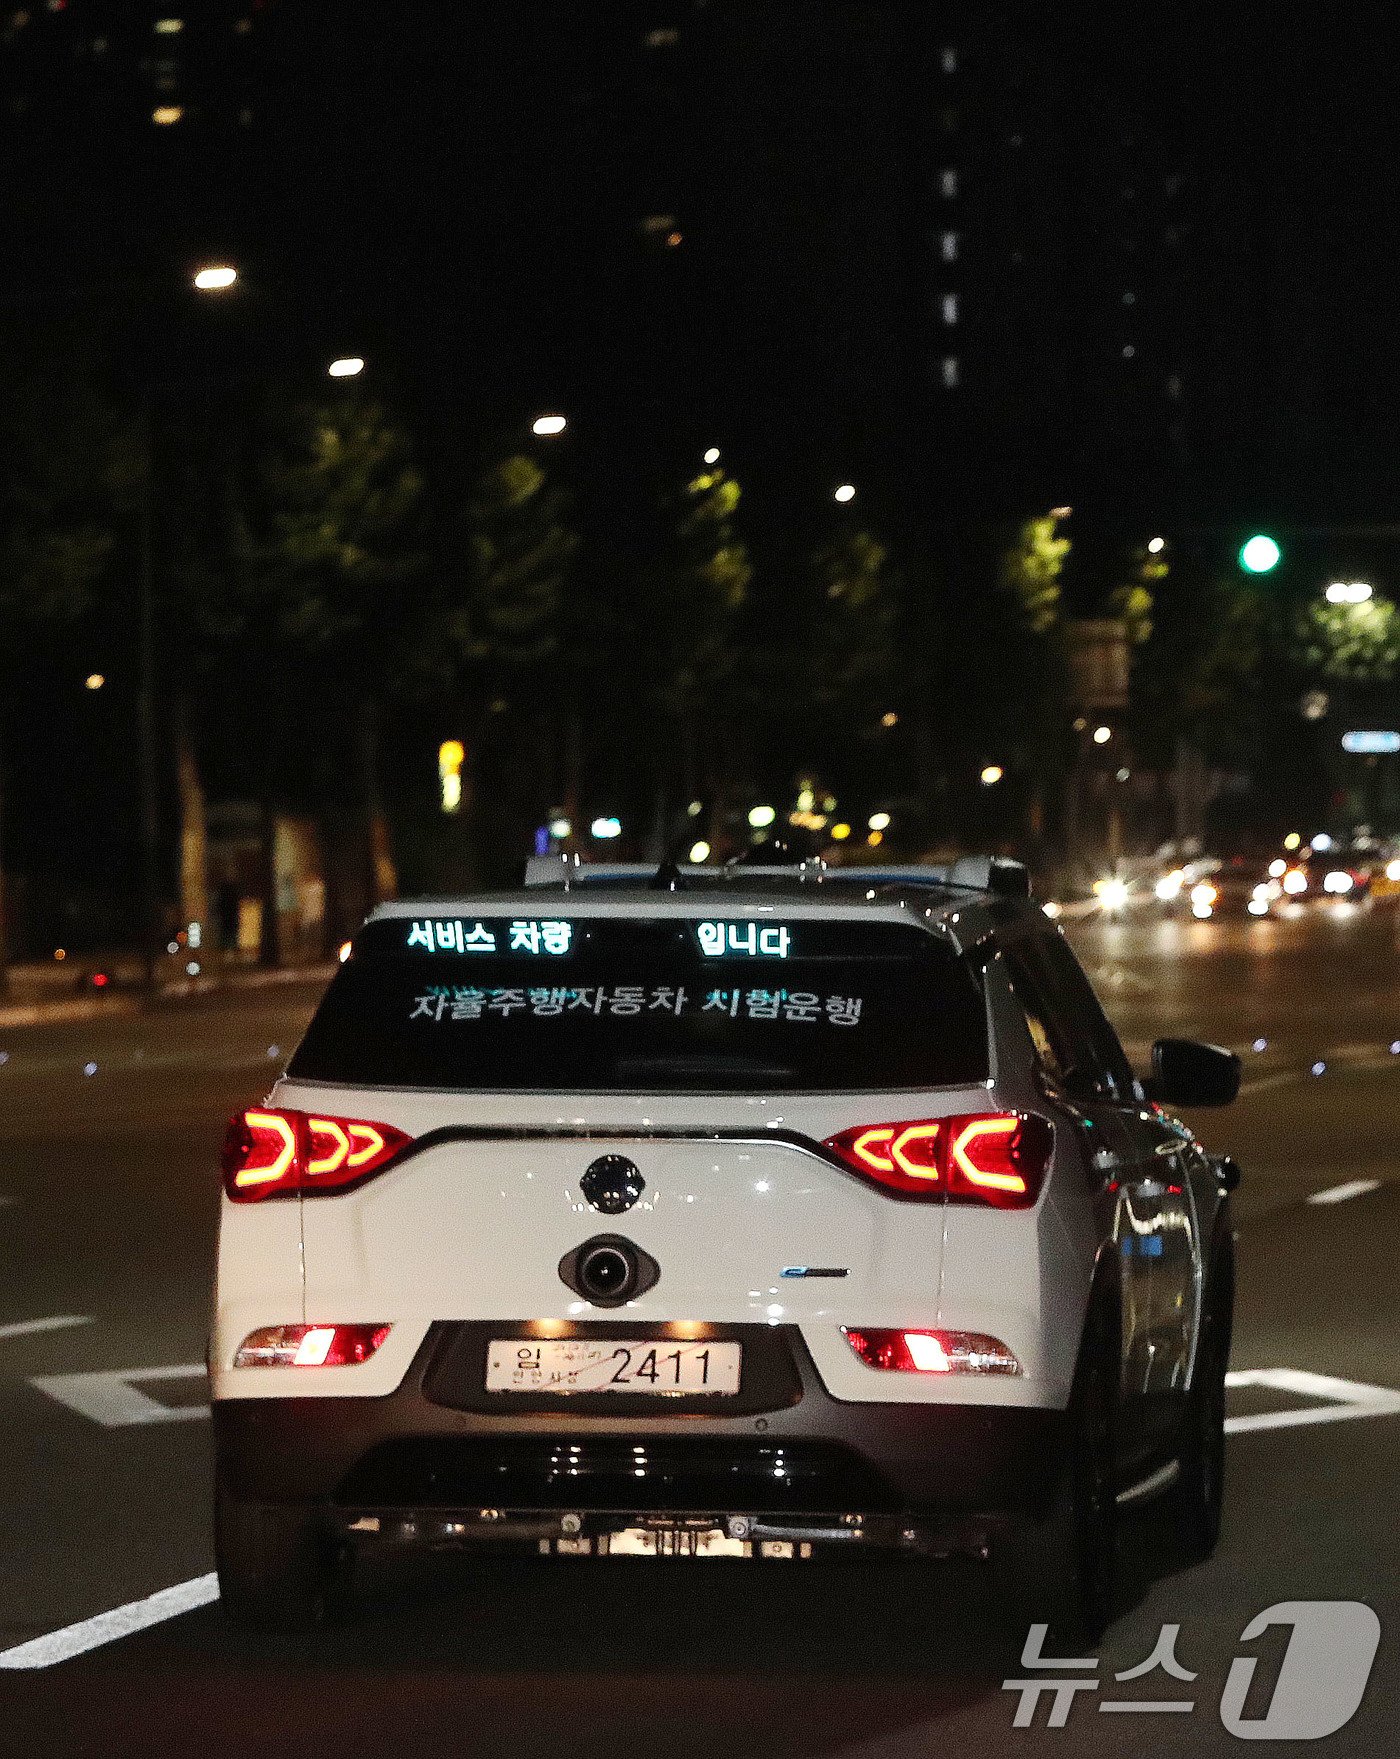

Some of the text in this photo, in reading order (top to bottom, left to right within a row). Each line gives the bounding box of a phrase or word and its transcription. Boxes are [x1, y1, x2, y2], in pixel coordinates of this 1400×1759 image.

[406, 920, 791, 958] 서비스 차량 입니다
[408, 986, 864, 1026] 자율주행자동차 시험운행
[517, 1348, 541, 1369] 임
[611, 1348, 710, 1384] 2411
